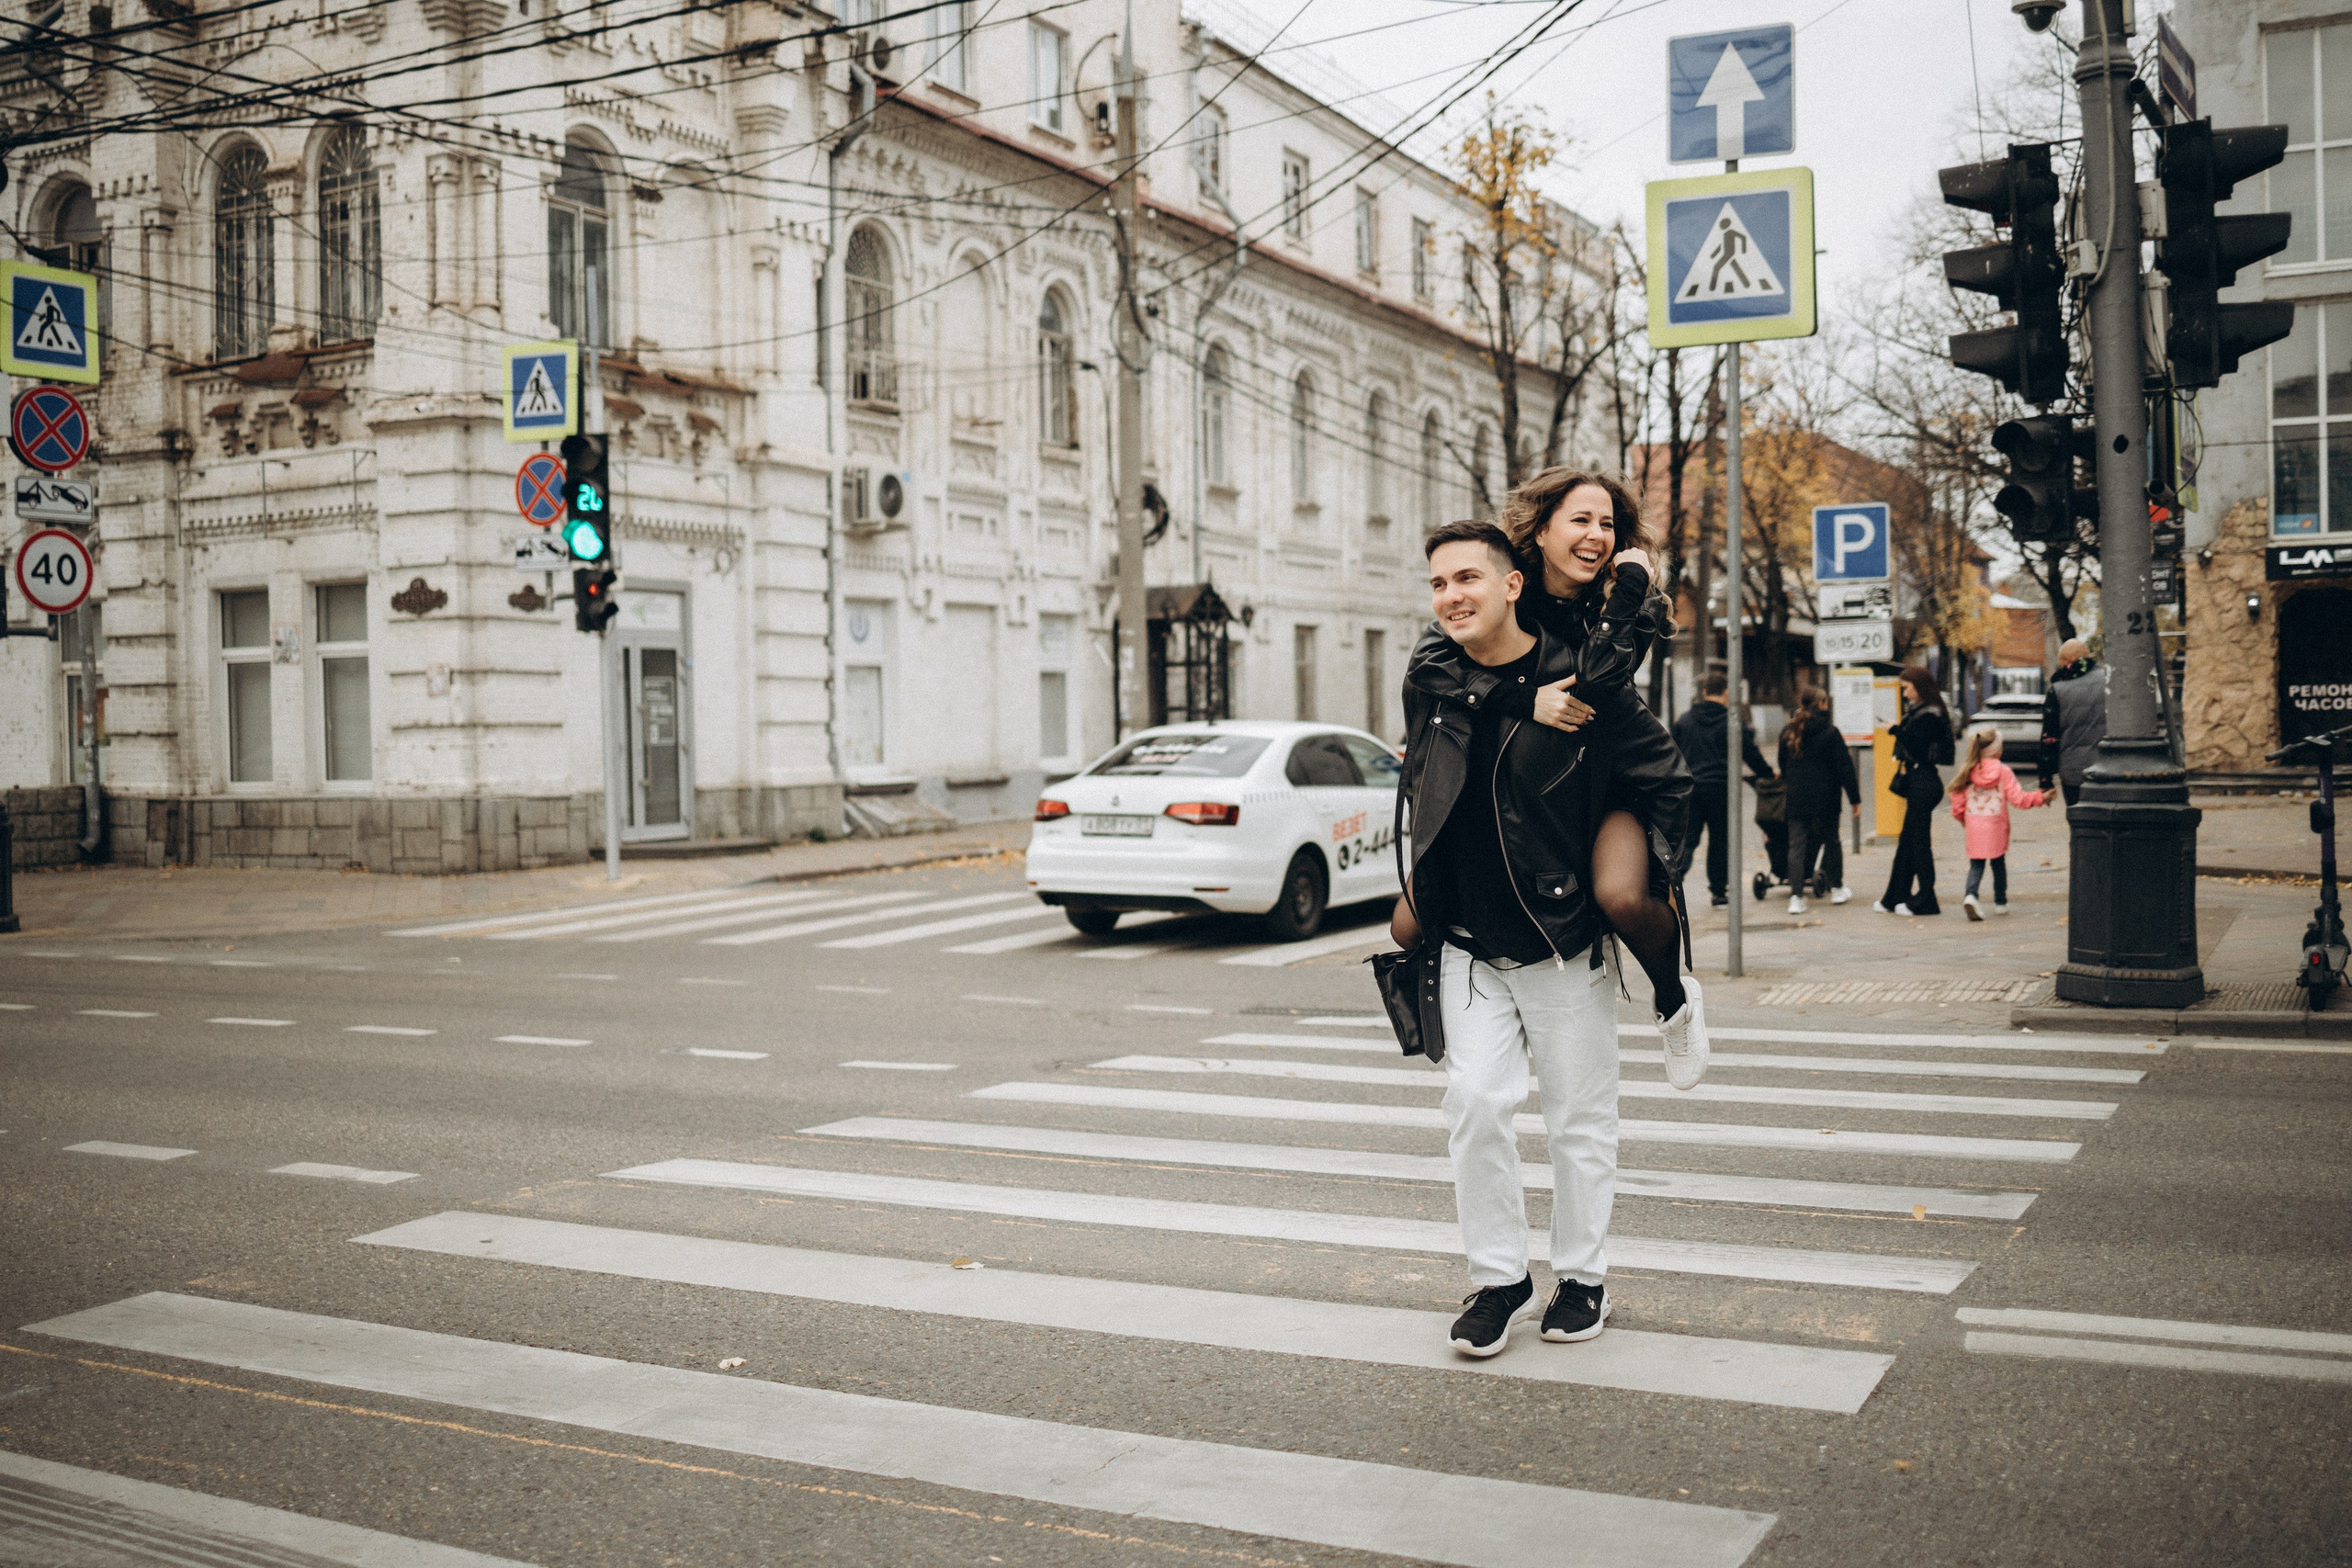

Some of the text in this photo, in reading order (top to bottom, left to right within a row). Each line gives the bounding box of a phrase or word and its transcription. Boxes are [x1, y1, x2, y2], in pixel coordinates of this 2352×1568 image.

[1834, 513, 1875, 573] P
[31, 553, 77, 585] 40
[1860, 633, 1883, 649] 20
